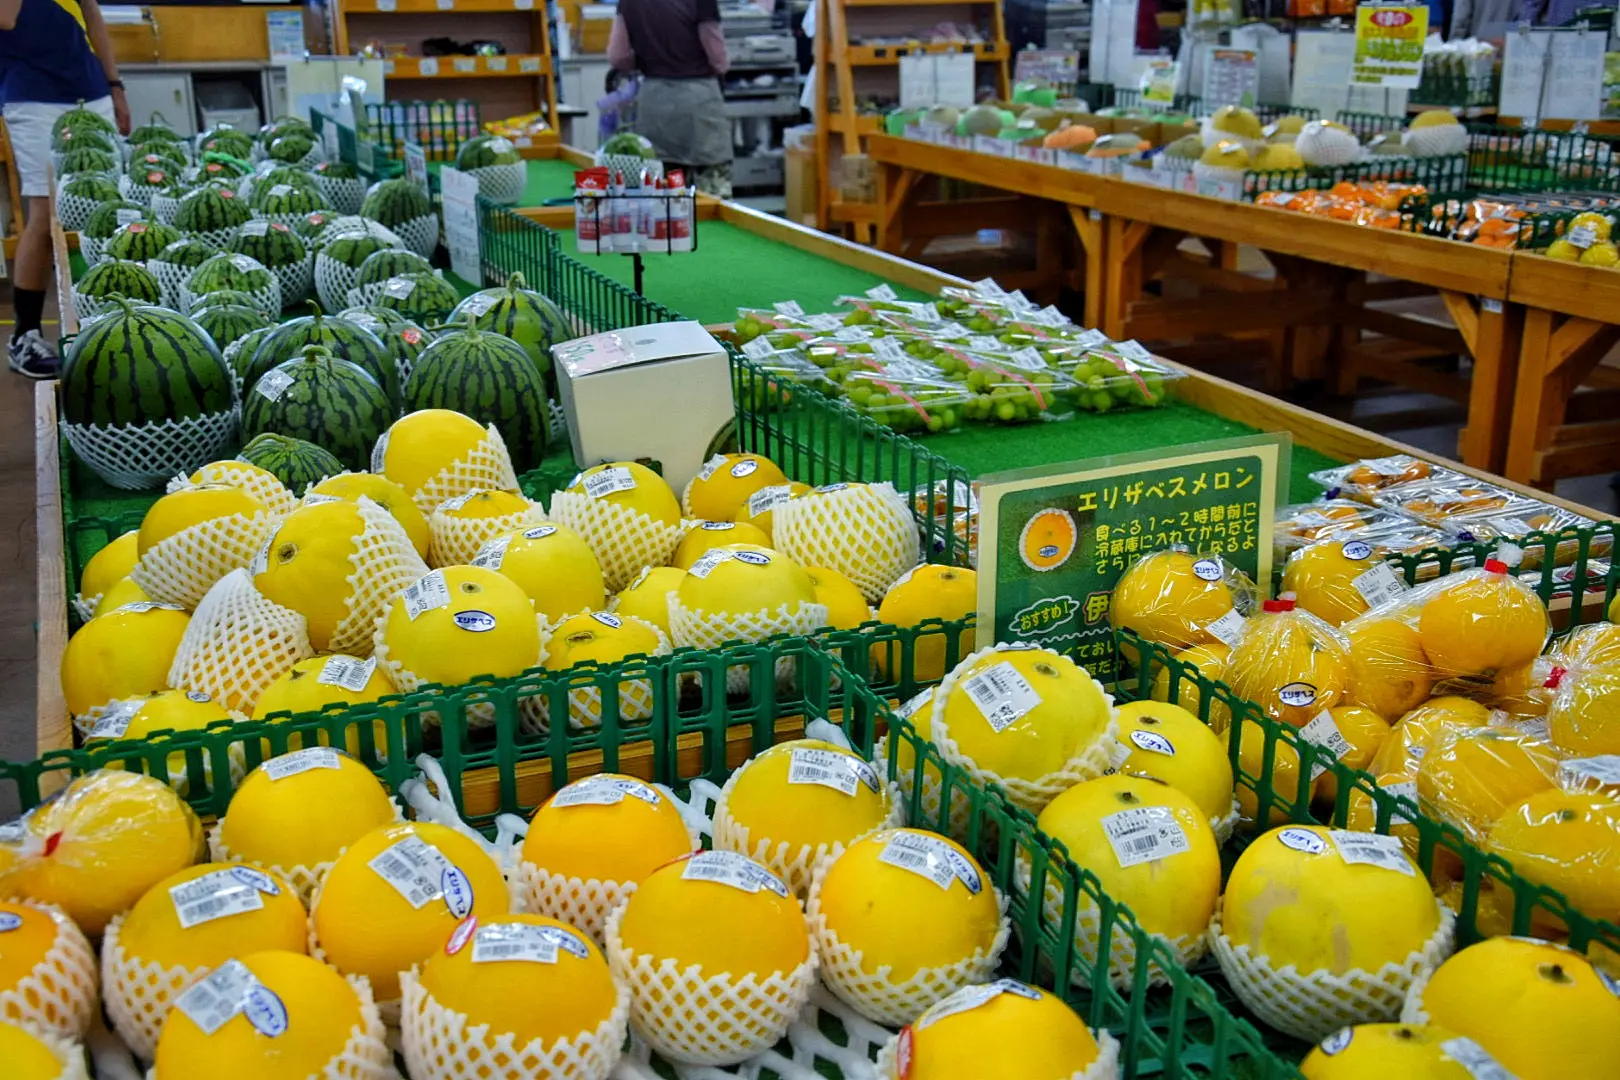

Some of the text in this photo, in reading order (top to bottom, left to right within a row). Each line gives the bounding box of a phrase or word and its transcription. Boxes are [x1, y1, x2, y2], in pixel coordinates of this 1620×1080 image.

[1078, 467, 1255, 512] エリザベスメロン
